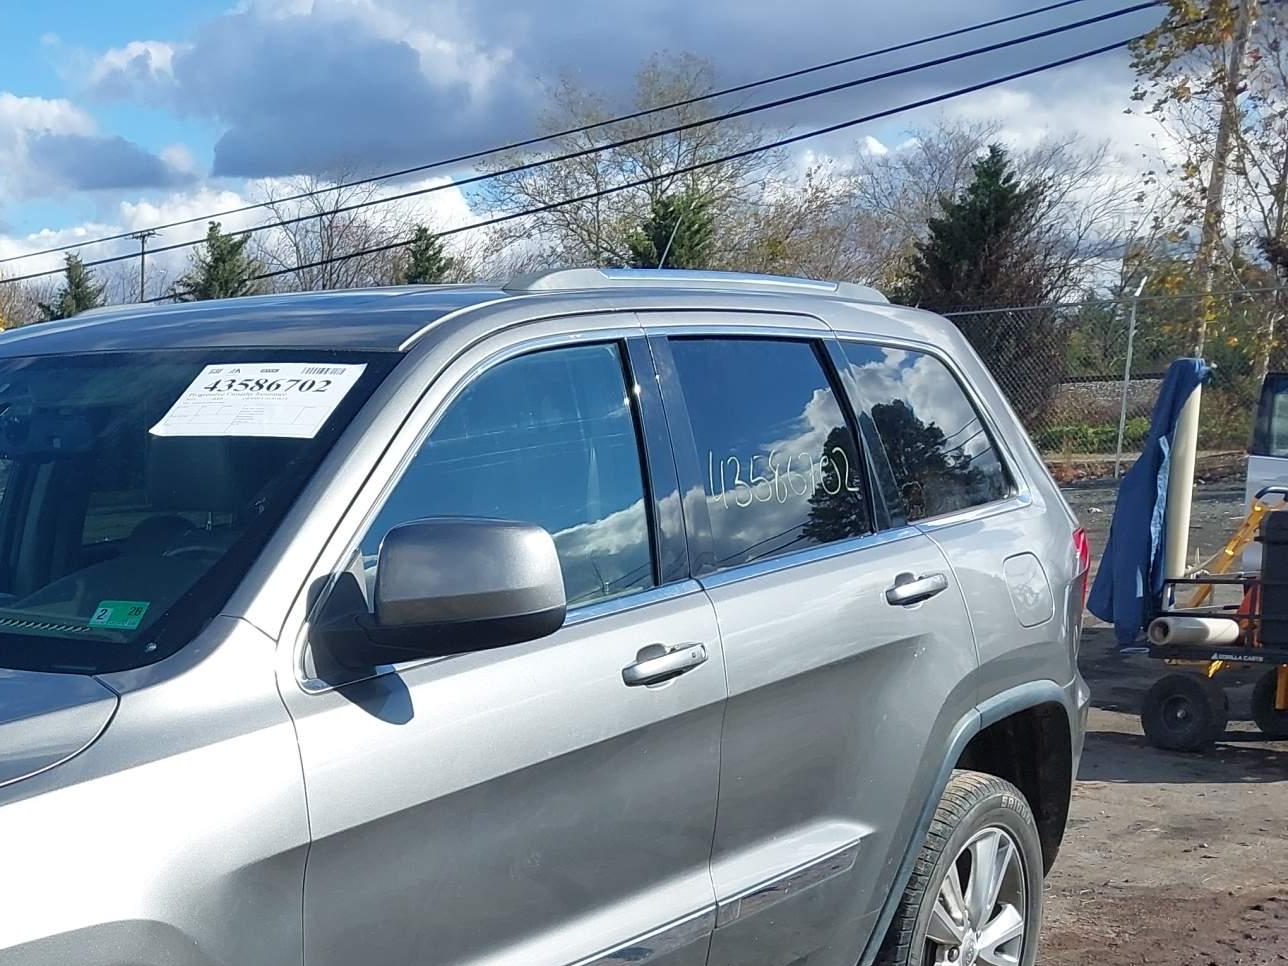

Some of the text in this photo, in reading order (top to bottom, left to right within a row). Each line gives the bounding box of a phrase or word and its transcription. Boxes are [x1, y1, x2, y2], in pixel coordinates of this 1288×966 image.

[203, 377, 333, 392] 43586702
[708, 447, 861, 510] 43586702
[96, 608, 108, 620] 2
